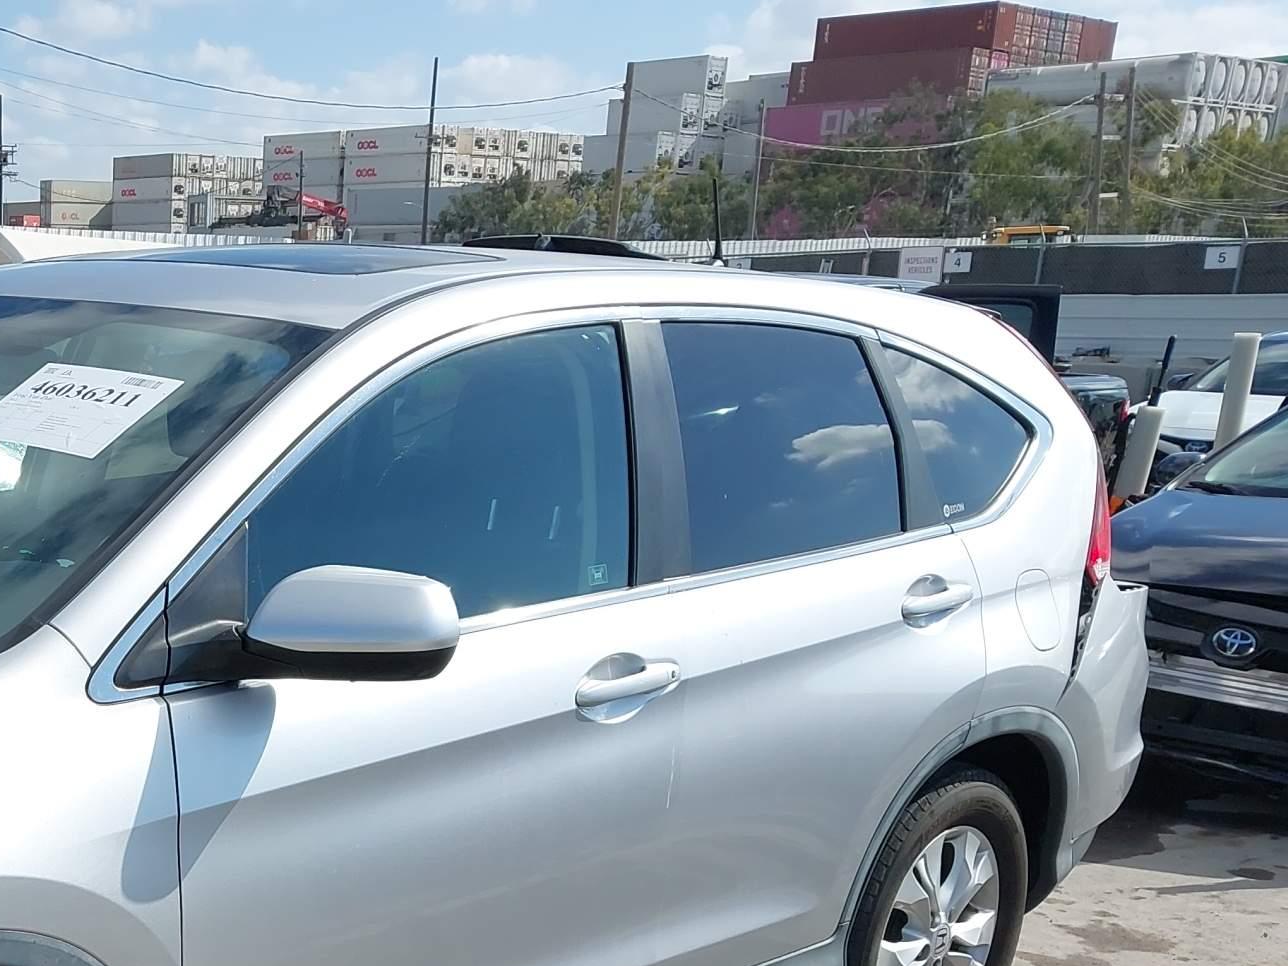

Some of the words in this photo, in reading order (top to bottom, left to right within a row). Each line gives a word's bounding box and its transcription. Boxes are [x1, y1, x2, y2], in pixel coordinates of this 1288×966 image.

[61, 212, 80, 220] OCL
[954, 257, 961, 267] 4
[1218, 252, 1226, 263] 5
[31, 380, 143, 408] 46036211
